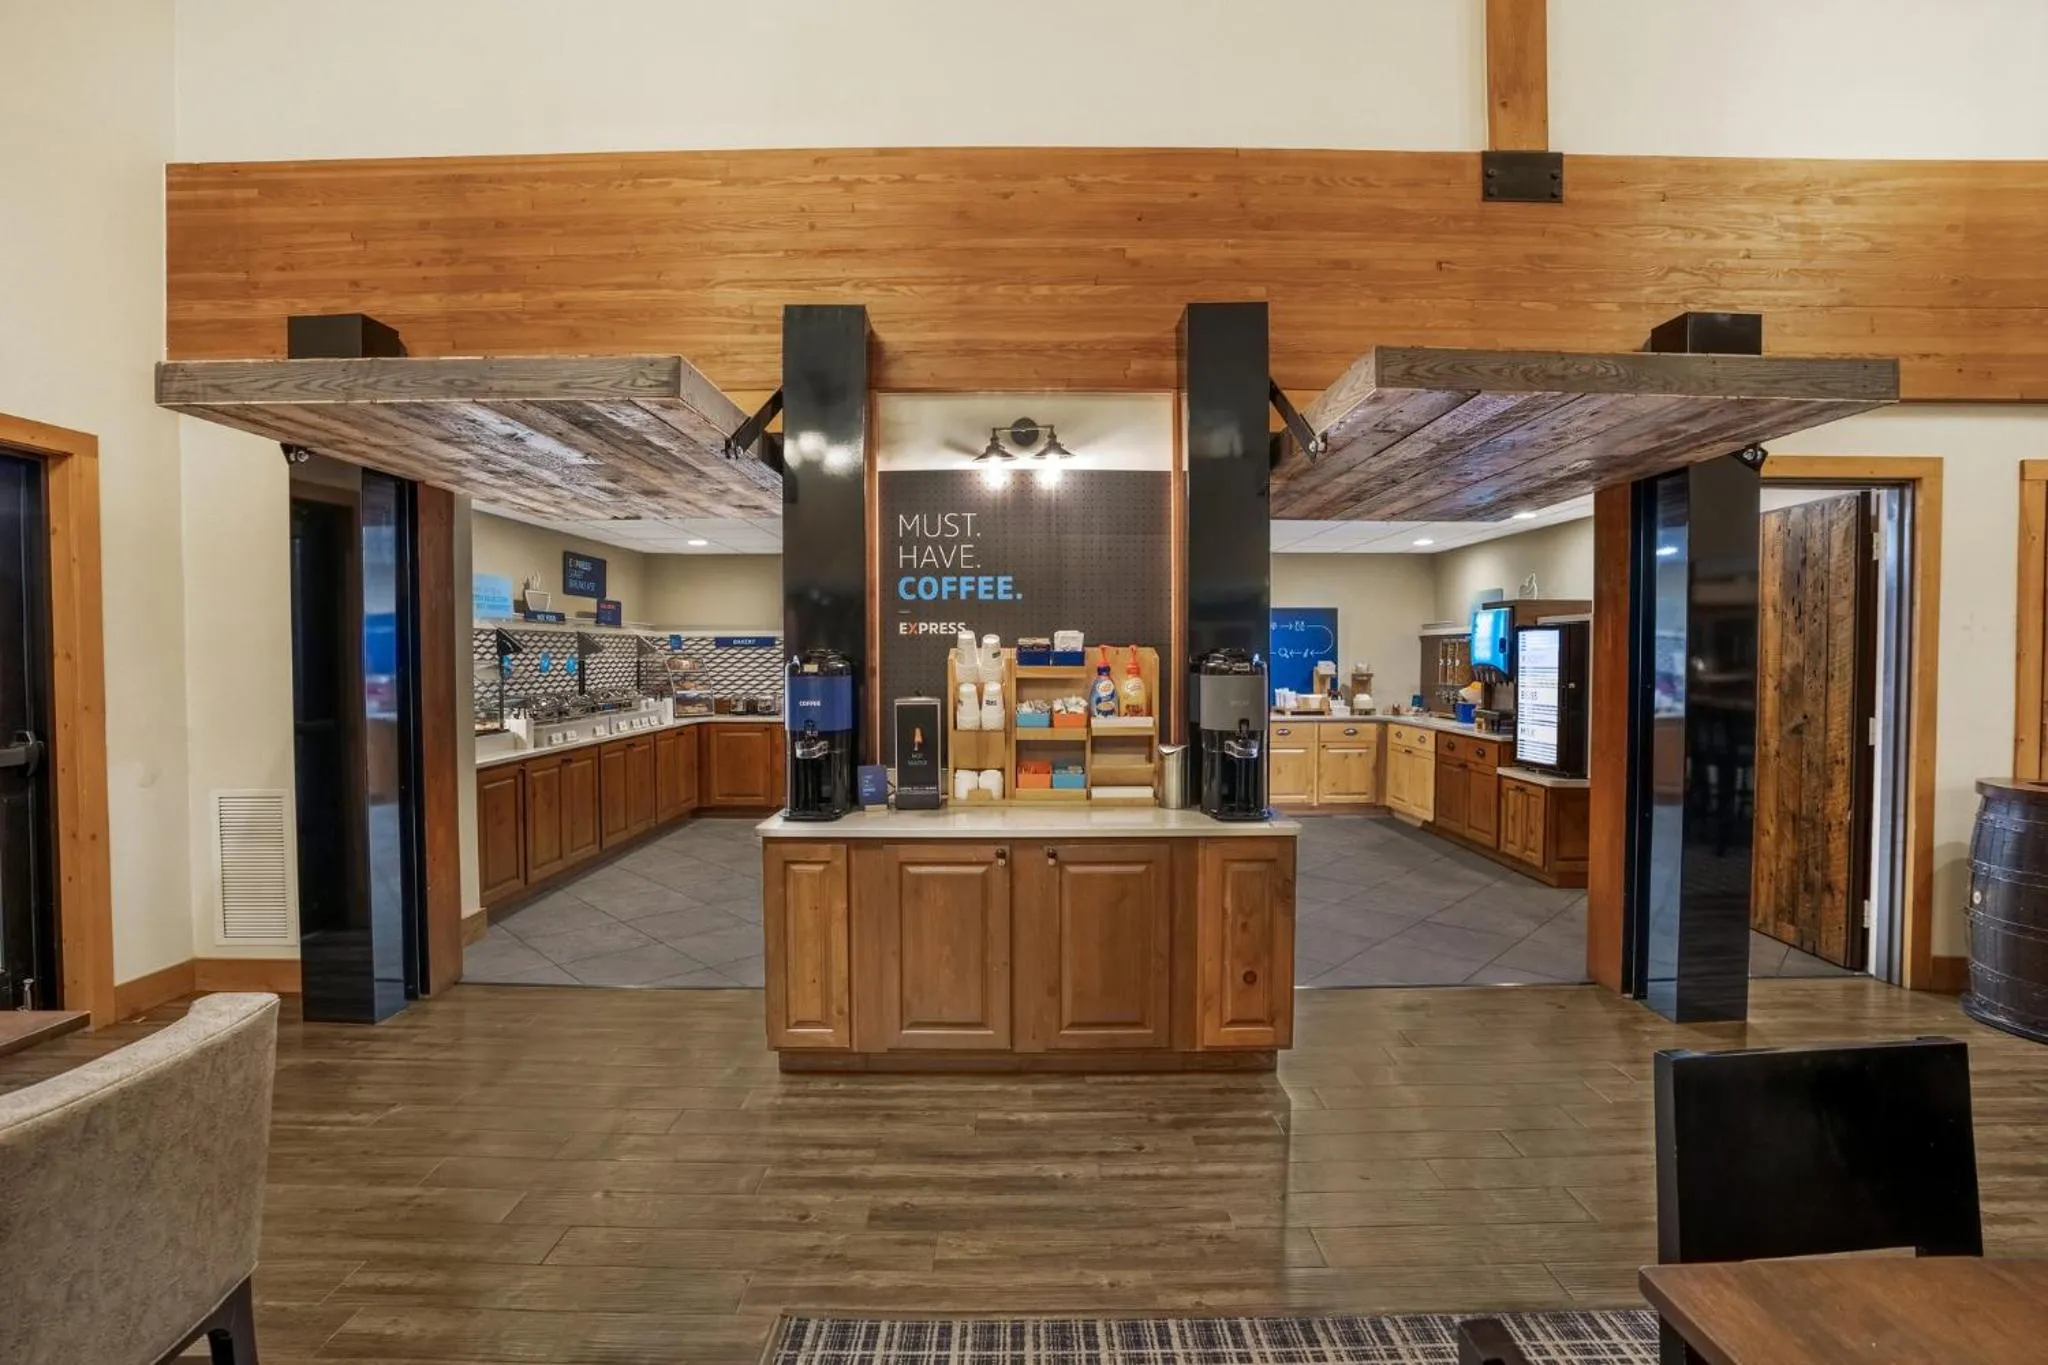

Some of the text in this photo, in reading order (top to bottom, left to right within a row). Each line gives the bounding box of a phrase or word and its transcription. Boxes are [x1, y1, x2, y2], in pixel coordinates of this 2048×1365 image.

[899, 513, 981, 537] MUST.
[899, 544, 981, 569] HAVE.
[898, 576, 1023, 600] COFFEE.
[899, 622, 967, 635] EXPRESS
